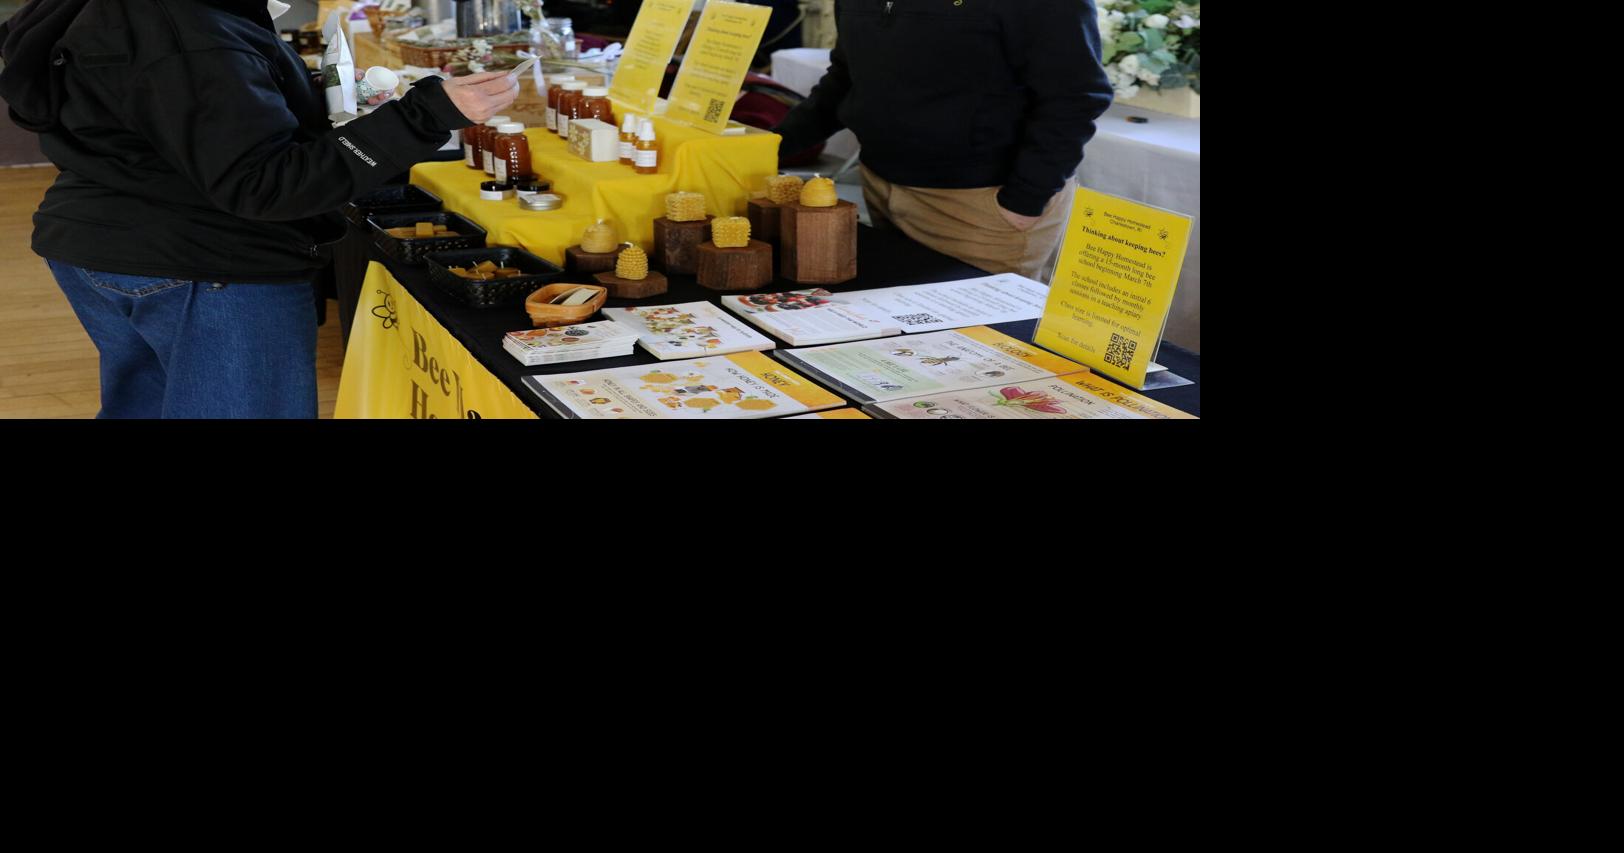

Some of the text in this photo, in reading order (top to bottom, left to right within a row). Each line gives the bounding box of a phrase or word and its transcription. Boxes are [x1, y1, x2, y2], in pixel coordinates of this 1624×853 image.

[338, 136, 377, 167] WEATHER SHIELD
[1127, 217, 1151, 230] Homestead
[1082, 226, 1166, 257] Thinking about keeping bees?
[1079, 250, 1099, 262] offering
[1106, 257, 1131, 272] 15-month
[1132, 267, 1144, 278] long
[1146, 271, 1156, 280] bee
[1097, 246, 1114, 258] Happy
[1116, 252, 1146, 269] Homestead
[1071, 271, 1081, 279] The
[1082, 275, 1098, 285] school
[1099, 280, 1121, 294] includes
[1130, 292, 1147, 303] initial
[1079, 258, 1152, 288] school beginning March 7th
[1071, 281, 1089, 290] classes
[1090, 286, 1113, 300] followed
[1122, 298, 1144, 312] monthly
[1102, 299, 1124, 313] teaching
[1060, 300, 1074, 310] Class
[1075, 306, 1086, 314] size
[1092, 311, 1111, 324] limited
[1111, 319, 1120, 328] for
[1120, 324, 1142, 336] optimal
[411, 326, 450, 396] Bee
[740, 375, 757, 386] HONEY
[760, 372, 790, 387] HONEY
[410, 379, 437, 419] H
[1048, 384, 1096, 406] POLLINATION
[1075, 380, 1104, 394] WHAT
[1112, 394, 1171, 419] POLLINATIO
